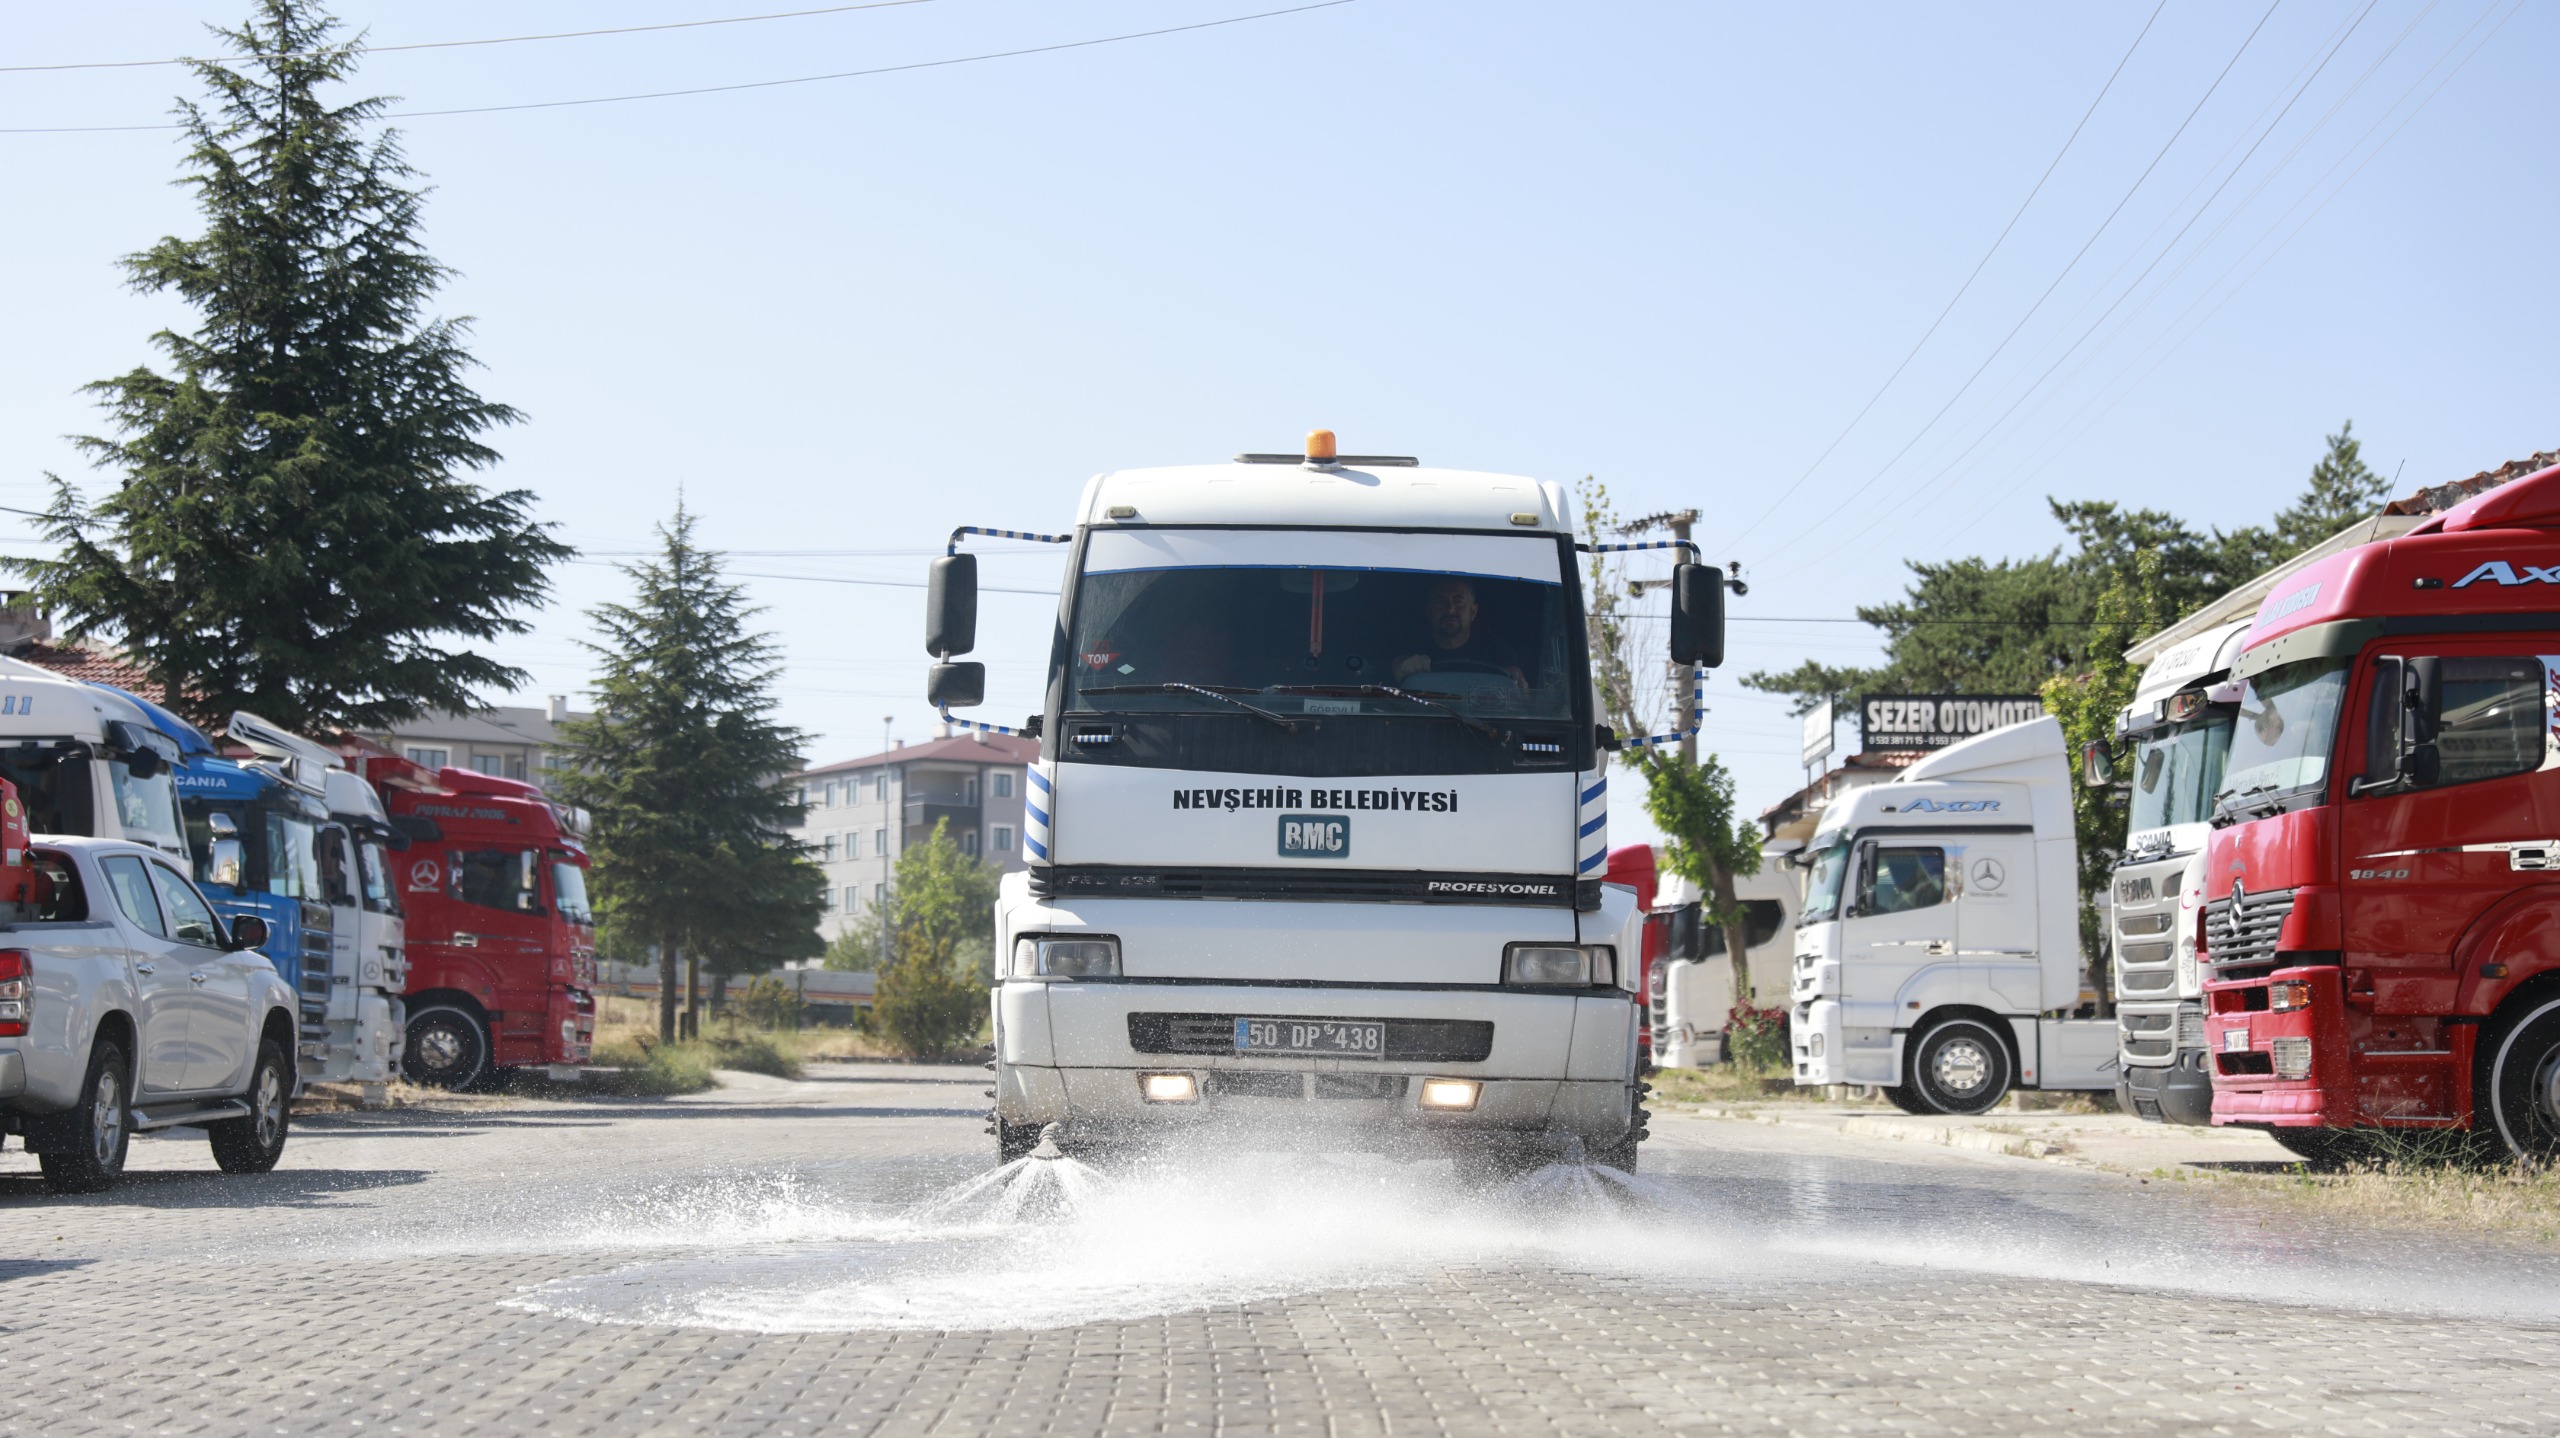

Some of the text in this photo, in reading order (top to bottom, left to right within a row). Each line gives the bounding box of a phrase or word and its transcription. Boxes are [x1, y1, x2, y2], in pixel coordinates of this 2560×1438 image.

[1087, 653, 1109, 665] TON
[1867, 700, 1936, 733] SEZER
[1869, 736, 1875, 745] 0
[174, 775, 228, 788] CANIA
[1173, 786, 1459, 813] NEVŞEHİR BELEDİYESİ
[1285, 822, 1343, 851] BMC
[2350, 869, 2409, 880] 1840
[1428, 881, 1558, 895] PROFESYONEL
[1250, 1023, 1278, 1047] 50
[1291, 1025, 1320, 1048] DP
[1334, 1026, 1378, 1050] 438
